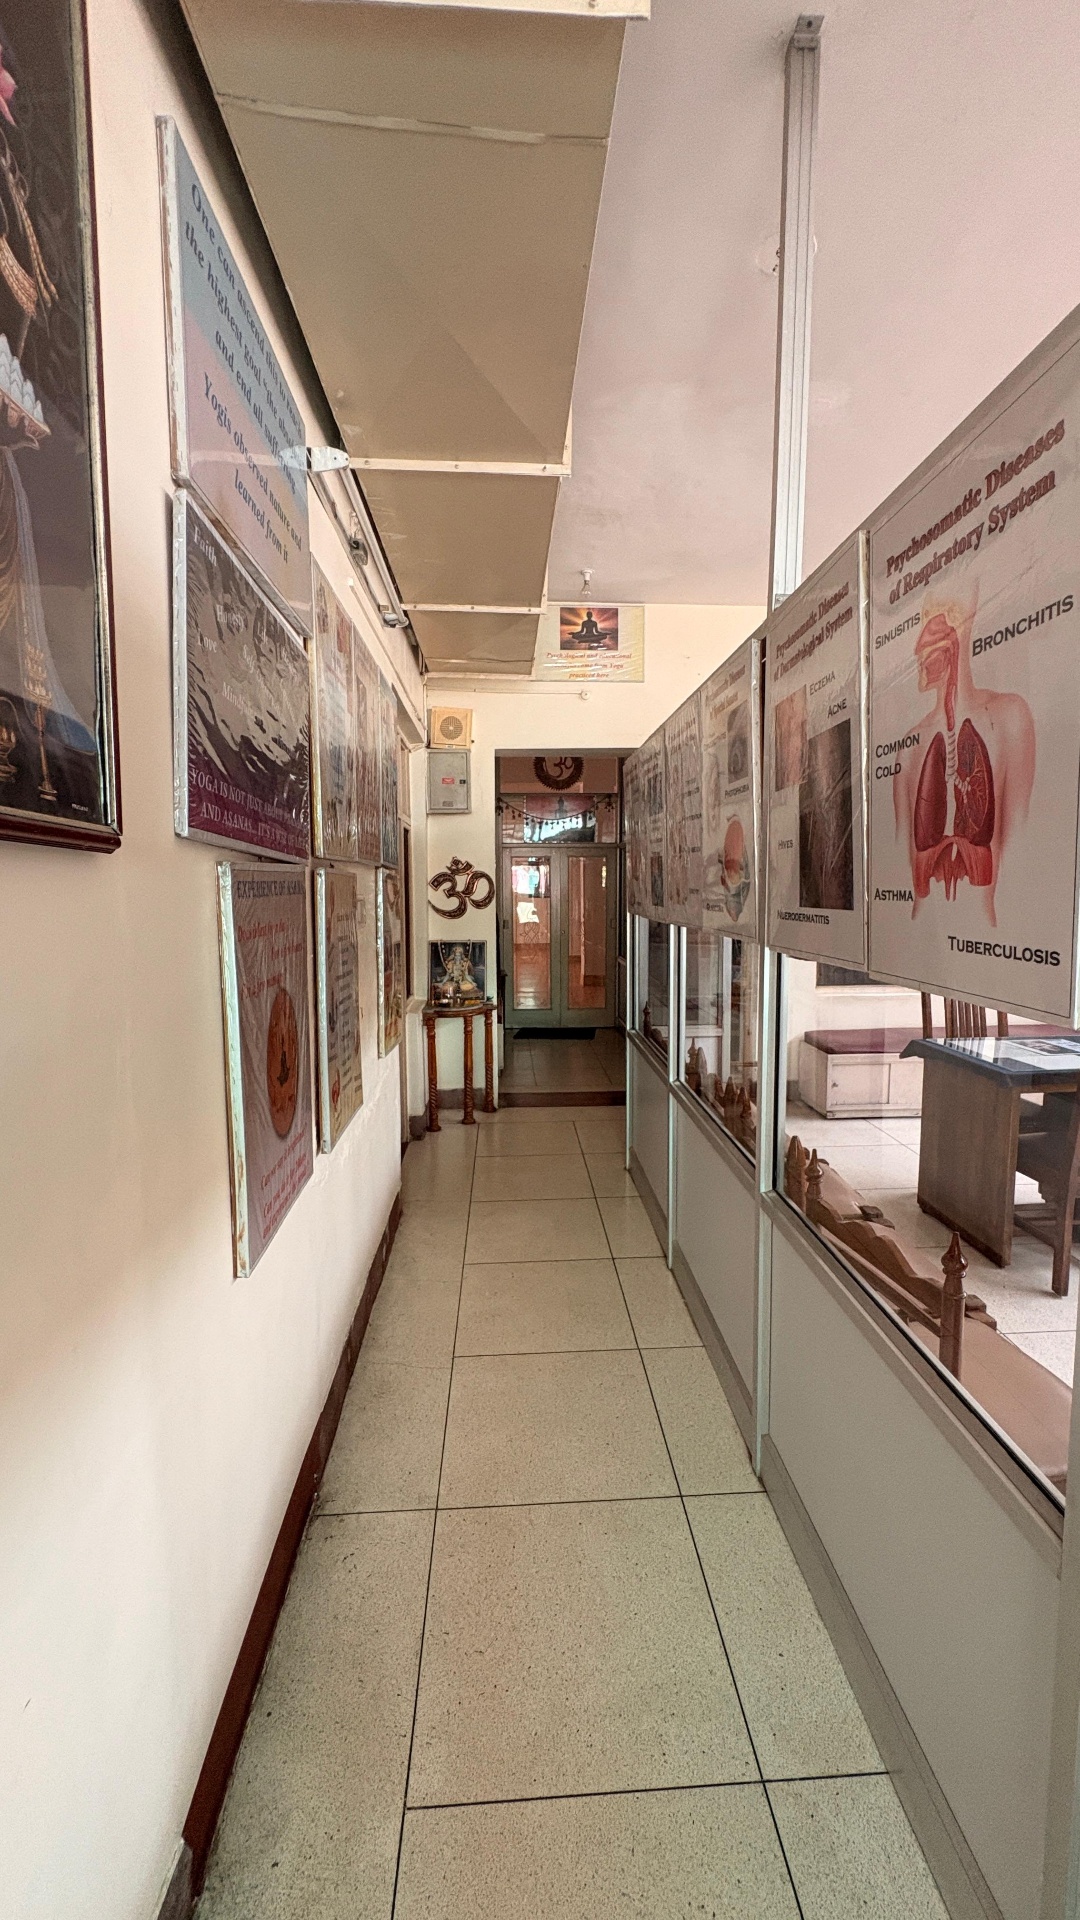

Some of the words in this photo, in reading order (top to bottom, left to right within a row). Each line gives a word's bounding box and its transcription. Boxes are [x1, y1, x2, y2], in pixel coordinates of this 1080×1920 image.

[185, 221, 205, 268] the
[207, 262, 244, 340] highest
[244, 341, 262, 387] goal
[191, 184, 215, 241] One
[217, 245, 236, 289] can
[237, 288, 265, 354] ascend
[265, 352, 279, 386] this
[279, 382, 286, 402] to
[215, 328, 234, 370] and
[236, 371, 252, 405] end
[253, 400, 263, 428] all
[264, 423, 296, 496] suffering
[204, 372, 232, 434] Yogis
[233, 430, 269, 495] observed
[269, 489, 290, 531] nature
[291, 525, 302, 552] and
[234, 468, 265, 529] learned
[265, 518, 282, 556] from
[282, 546, 288, 564] it
[886, 487, 982, 578] Psychosomatic
[984, 418, 1065, 500] Diseases
[193, 526, 217, 567] Faith
[889, 576, 902, 604] of
[902, 522, 984, 596] Respiratory
[988, 470, 1056, 535] System
[776, 610, 818, 659] Psychosomatic
[818, 582, 849, 620] Diseases
[825, 606, 853, 640] System
[875, 612, 921, 650] SINUSITIS
[972, 594, 1074, 657] BRONCHITIS
[810, 670, 836, 696] ECZEMA
[827, 698, 847, 718] ACNE
[875, 733, 920, 758] COMMON
[875, 762, 902, 780] COLD
[190, 767, 217, 795] YOGA
[220, 781, 226, 798] IS
[228, 785, 245, 806] NOT
[246, 793, 262, 818] JUST
[200, 800, 221, 823] AND
[778, 839, 793, 850] HIVES
[236, 879, 277, 899] EXPERIENCE
[874, 888, 913, 902] ASTHMA
[777, 909, 830, 925] NUERODERMATITIS
[948, 935, 1061, 966] TUBERCULOSIS
